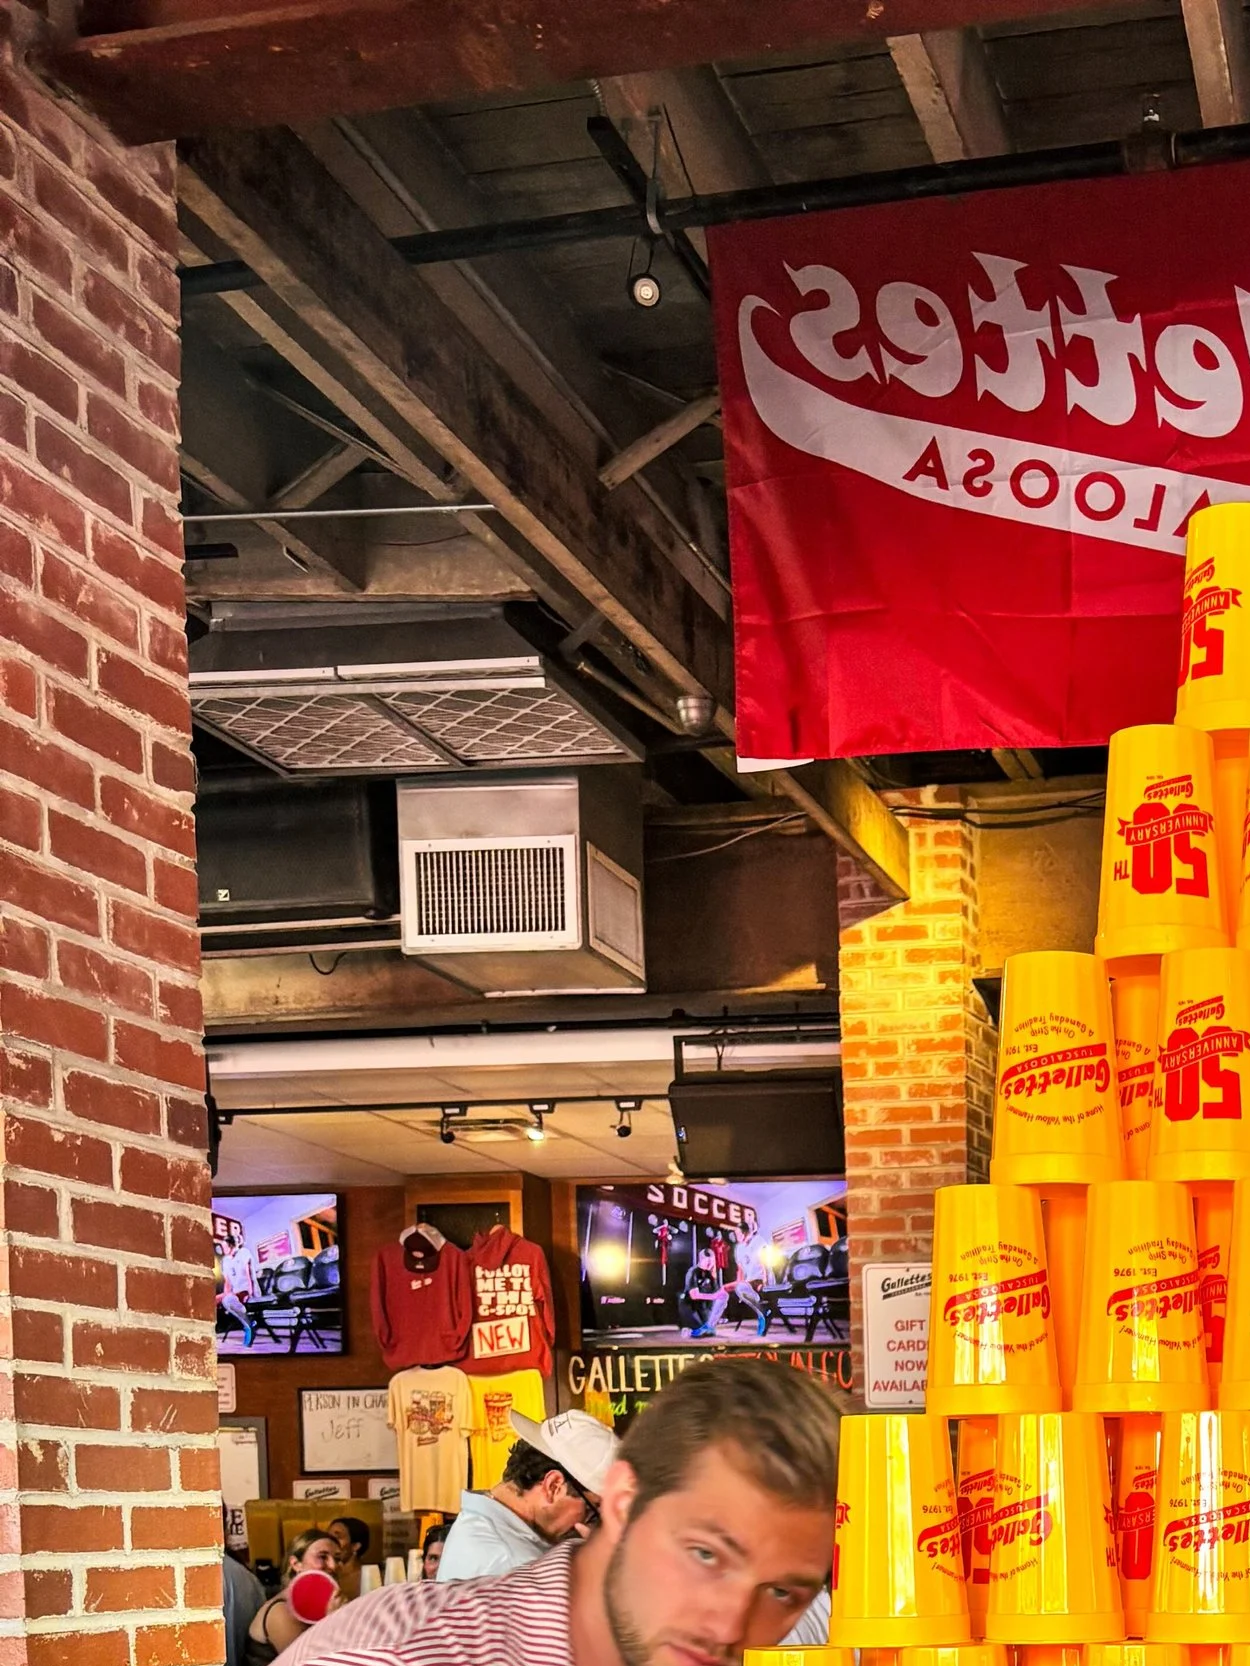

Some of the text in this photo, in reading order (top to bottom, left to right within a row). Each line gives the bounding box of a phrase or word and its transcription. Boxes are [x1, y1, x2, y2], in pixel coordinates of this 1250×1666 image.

[1146, 782, 1193, 800] Gallettes
[1130, 813, 1204, 842] ANNIVERSARY
[1114, 802, 1209, 898] 50 TH
[1176, 1004, 1224, 1028] Gallettes
[1026, 1049, 1093, 1072] TUSCALOOSA
[1161, 1036, 1238, 1071] ANNIVERSARY
[1002, 1058, 1110, 1099] Gallettes
[1164, 1027, 1242, 1122] 50
[647, 1184, 757, 1229] SOCCER
[477, 1277, 506, 1291] ME
[881, 1272, 932, 1292] Gallettes
[478, 1291, 534, 1305] THE
[948, 1284, 1049, 1326] Gallettes
[477, 1321, 524, 1352] NEW
[895, 1320, 926, 1332] GIFT
[895, 1360, 928, 1371] NOW
[348, 1394, 360, 1408] IN
[321, 1418, 364, 1441] Jeff
